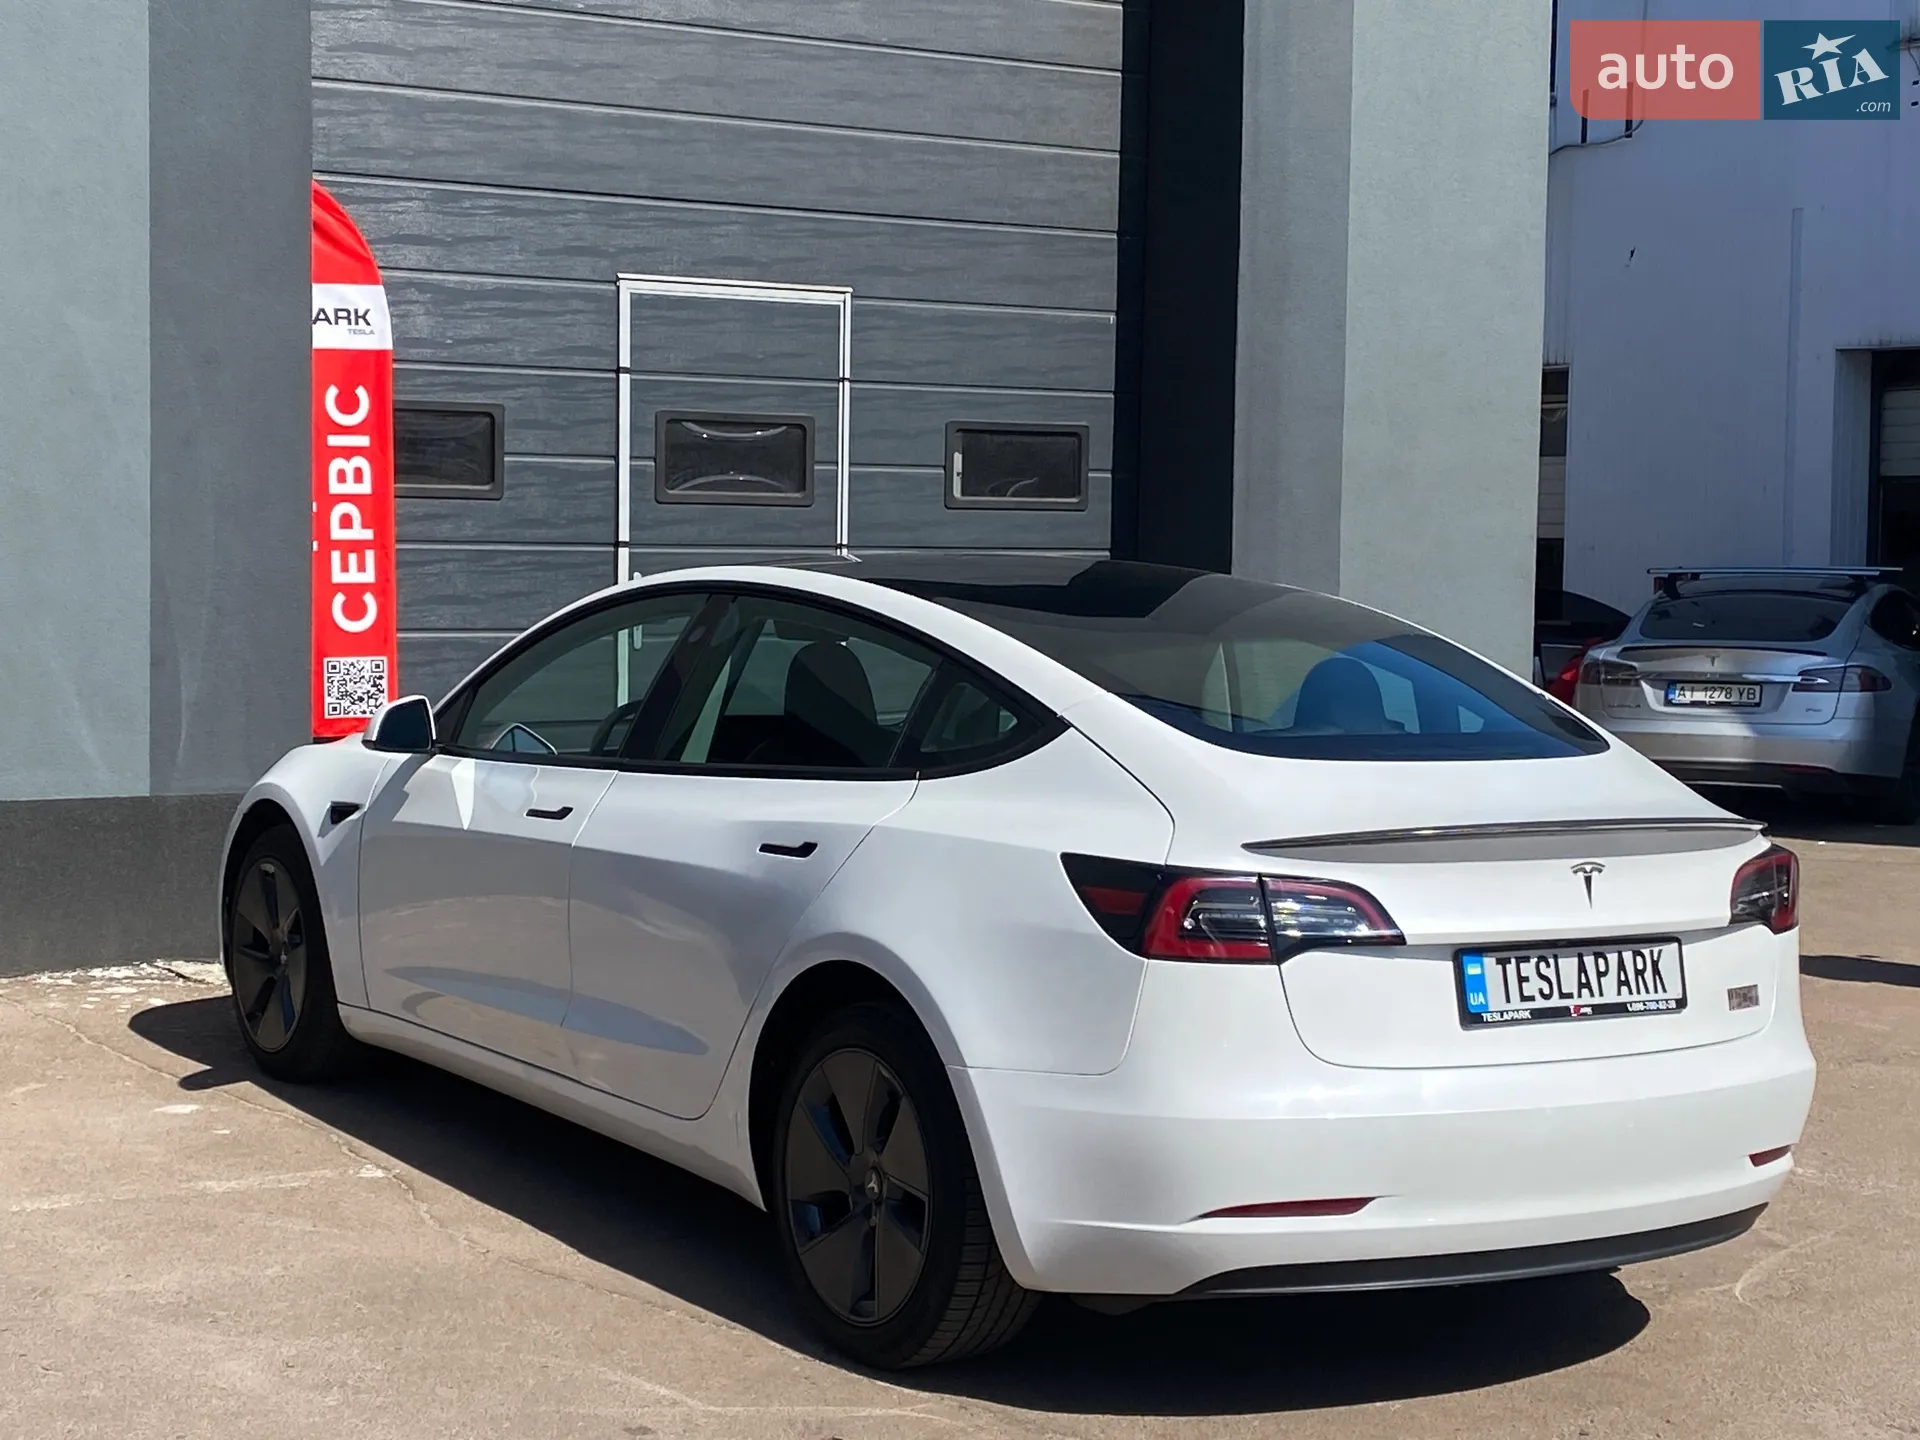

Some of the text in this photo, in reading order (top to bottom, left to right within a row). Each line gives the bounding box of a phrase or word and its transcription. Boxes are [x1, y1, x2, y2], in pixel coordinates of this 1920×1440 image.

[347, 328, 376, 336] TESLA
[324, 384, 378, 633] СЕРВІС
[1702, 685, 1733, 700] 1278
[1737, 687, 1757, 701] YB
[1495, 948, 1668, 1005] TESLAPARK
[1469, 991, 1487, 1006] UA
[1480, 1009, 1532, 1023] TESLAPARK
